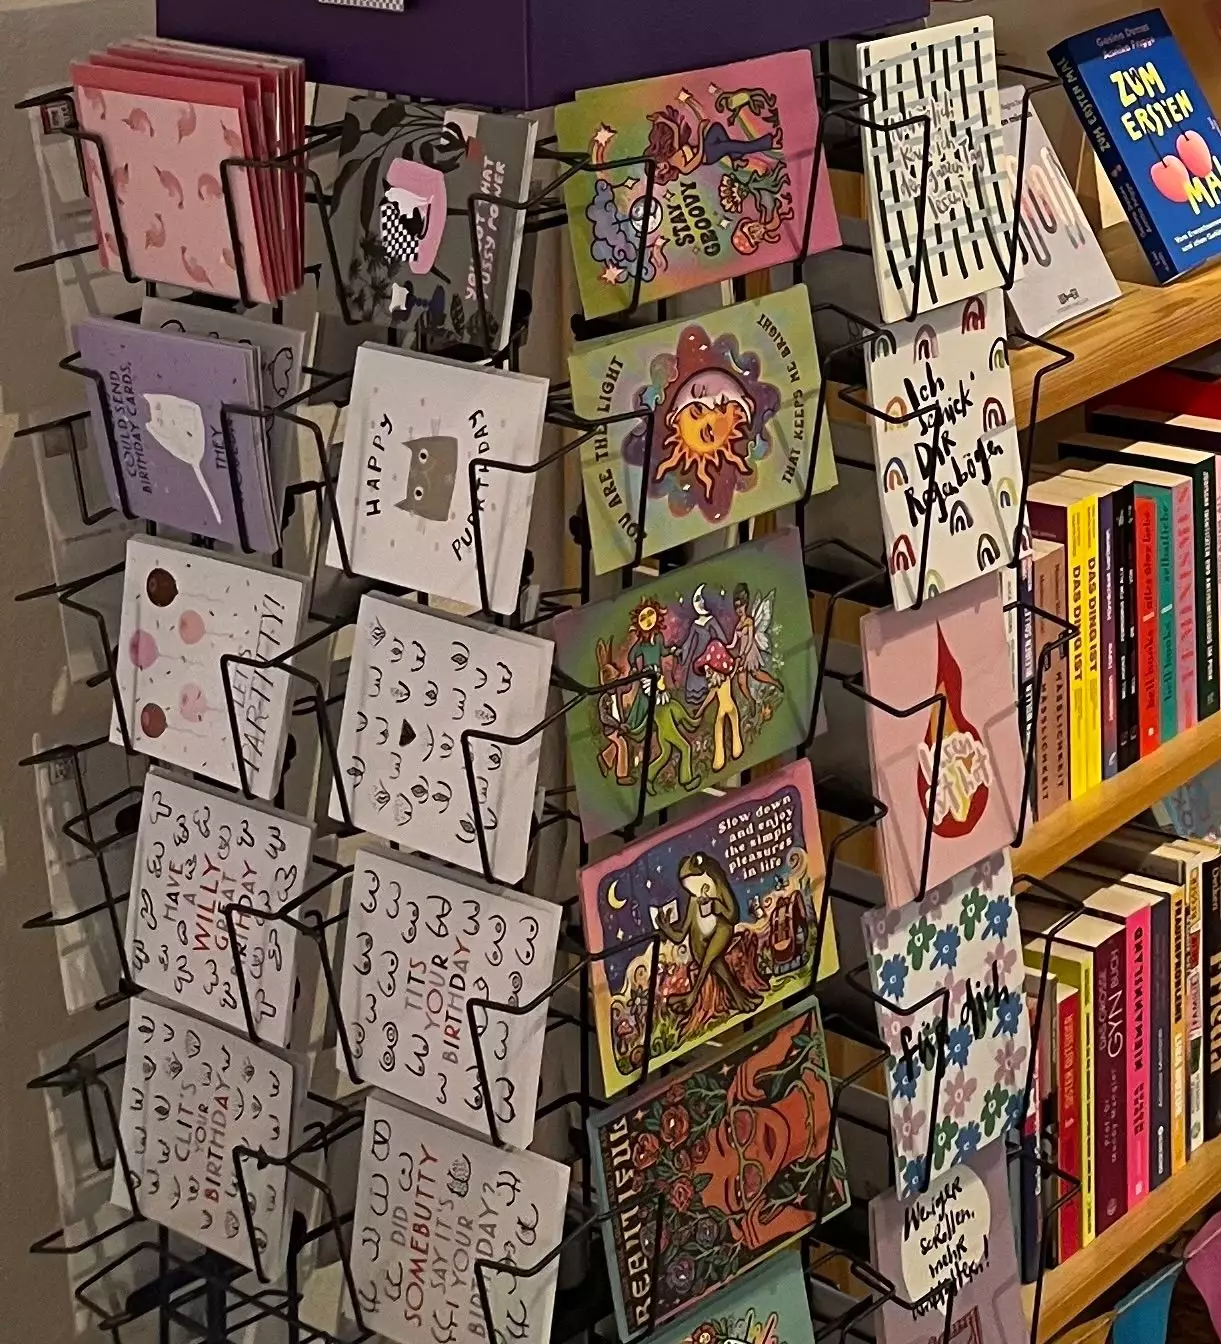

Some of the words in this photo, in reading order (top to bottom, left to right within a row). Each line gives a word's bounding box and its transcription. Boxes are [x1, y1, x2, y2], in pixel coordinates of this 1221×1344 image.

[1110, 61, 1167, 108] ZUM
[1120, 89, 1194, 141] ERSTEN
[1092, 129, 1111, 153] ZUM
[666, 203, 696, 247] STAY
[680, 181, 721, 257] GROOVY
[755, 312, 792, 359] BRIGHT
[109, 370, 123, 413] SEND
[597, 354, 625, 413] LIGHT
[785, 359, 802, 384] ME
[903, 361, 945, 411] Ich
[792, 389, 807, 441] KEEPS
[118, 417, 137, 477] COULD
[129, 420, 153, 494] BIRTHDAY
[210, 424, 228, 470] THEY
[366, 413, 393, 517] HAPPY
[781, 450, 801, 485] THAT
[599, 467, 624, 509] ARE
[1072, 565, 1082, 601] DAS
[1087, 556, 1097, 594] DAS
[1088, 596, 1098, 649] DING
[1073, 654, 1084, 681] IST
[1088, 651, 1098, 672] IST
[718, 811, 752, 834] Slow
[755, 795, 792, 818] down
[729, 822, 755, 843] and
[758, 805, 794, 830] enjoy
[724, 843, 746, 858] the
[750, 822, 793, 847] simple
[728, 836, 793, 874] pleasures
[163, 859, 184, 922] HAVE
[742, 867, 757, 880] in
[760, 857, 782, 873] life
[192, 853, 221, 951] WILLY
[404, 957, 427, 1010] TITS
[424, 954, 449, 1031] YOUR
[1109, 948, 1120, 988] BUCH
[442, 934, 471, 1064] BIRTHDAY
[960, 959, 1010, 1040] dich
[1107, 989, 1124, 1058] GYN
[174, 1080, 197, 1162] CLIT'S
[194, 1103, 209, 1152] YOUR
[204, 1071, 231, 1204] BIRTHDAY
[390, 1205, 409, 1247] DID
[404, 1143, 438, 1327] SOMEBUTTY
[435, 1197, 454, 1242] IT'S
[431, 1246, 447, 1295] SAY
[450, 1215, 475, 1288] YOUR
